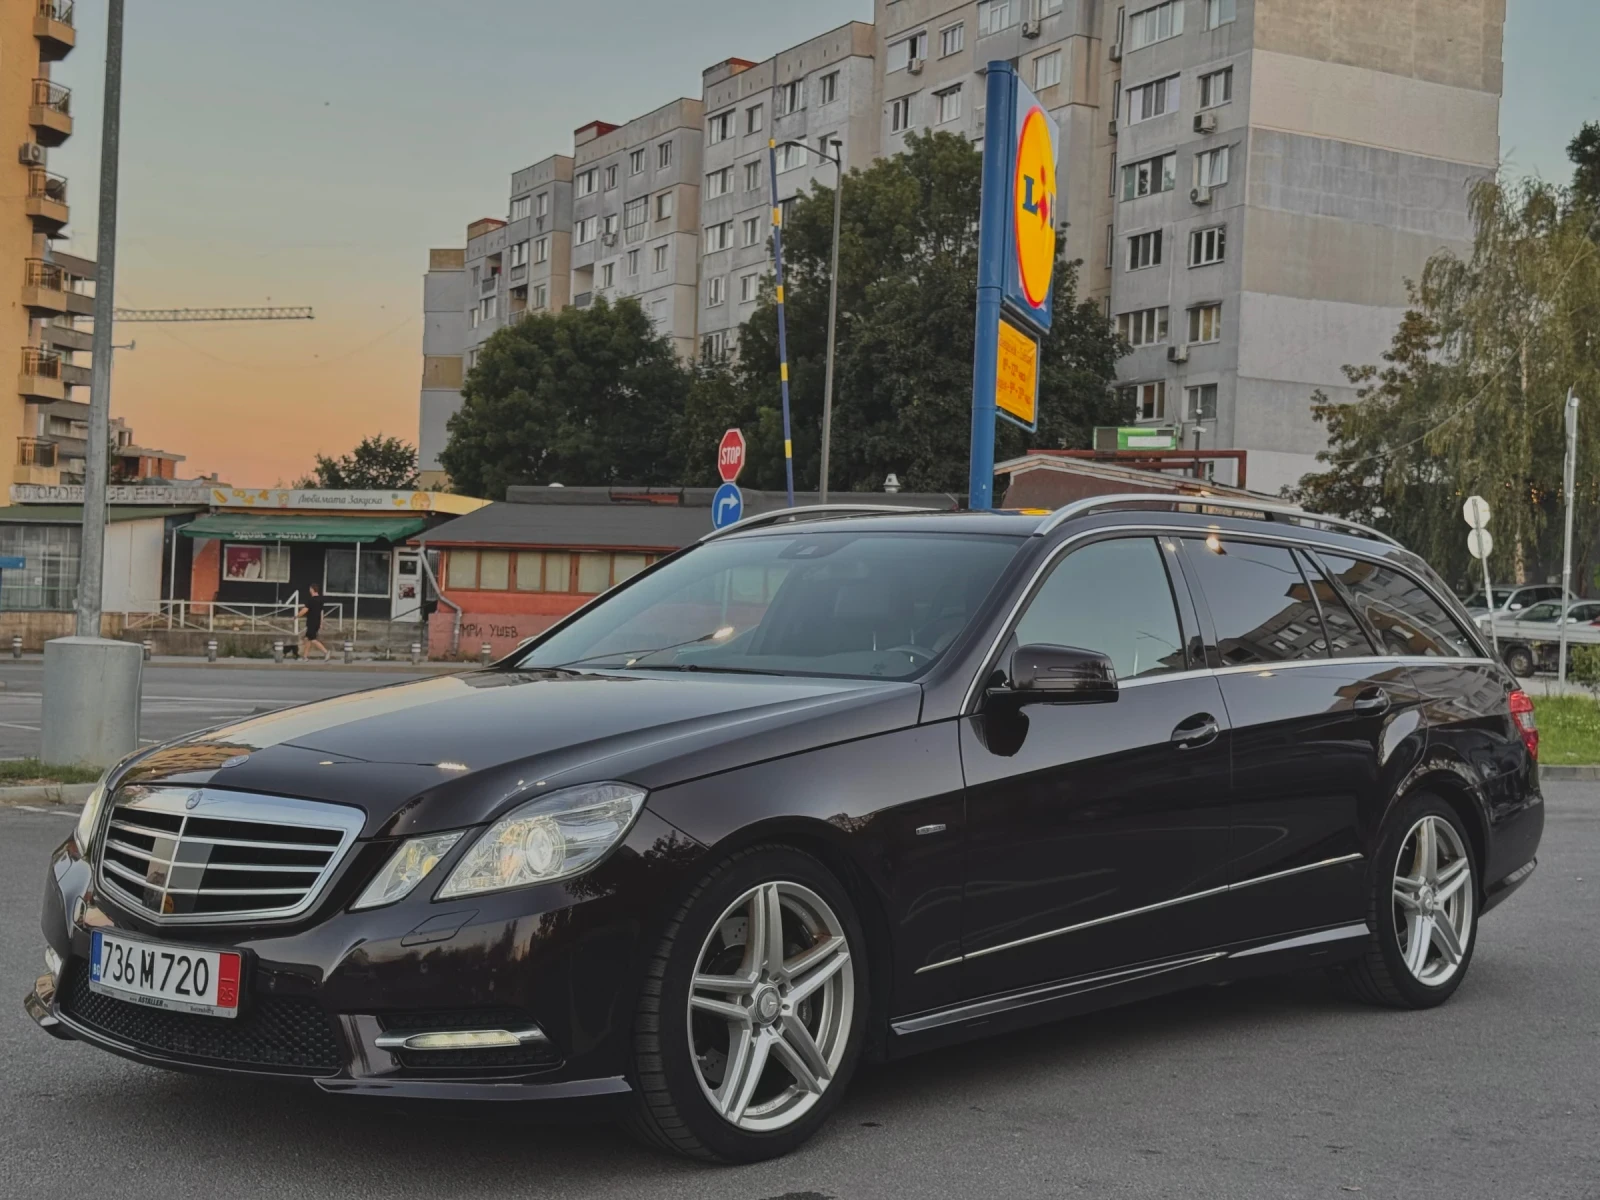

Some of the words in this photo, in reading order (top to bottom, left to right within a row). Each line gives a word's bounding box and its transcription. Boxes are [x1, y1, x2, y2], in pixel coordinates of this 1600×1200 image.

[721, 446, 741, 465] STOP
[347, 495, 383, 507] Закуска
[489, 624, 519, 638] УШЕВ
[93, 963, 101, 976] BG
[102, 941, 135, 985] 736
[140, 949, 155, 989] M
[159, 952, 209, 997] 720
